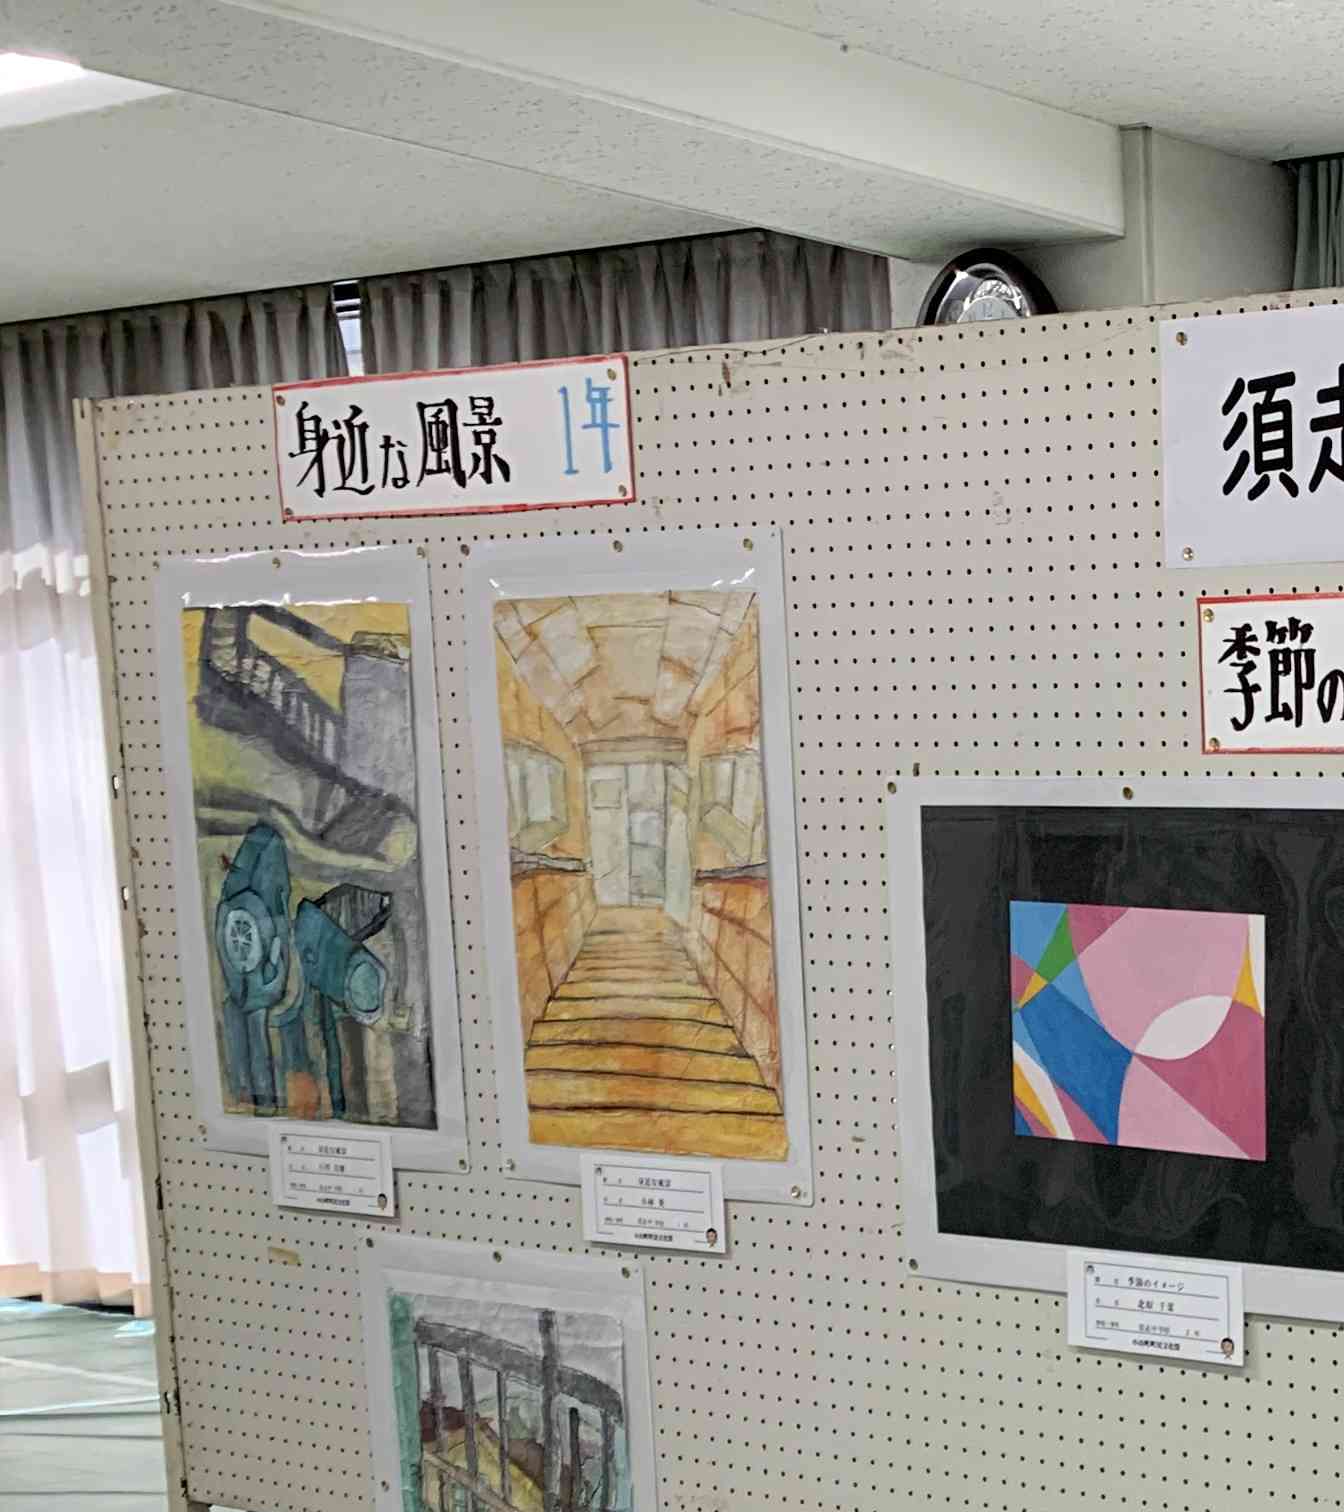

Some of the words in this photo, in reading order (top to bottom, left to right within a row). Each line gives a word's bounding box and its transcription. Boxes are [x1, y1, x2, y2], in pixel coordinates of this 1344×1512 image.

[288, 396, 511, 498] 身近な風景
[557, 376, 620, 475] 1年
